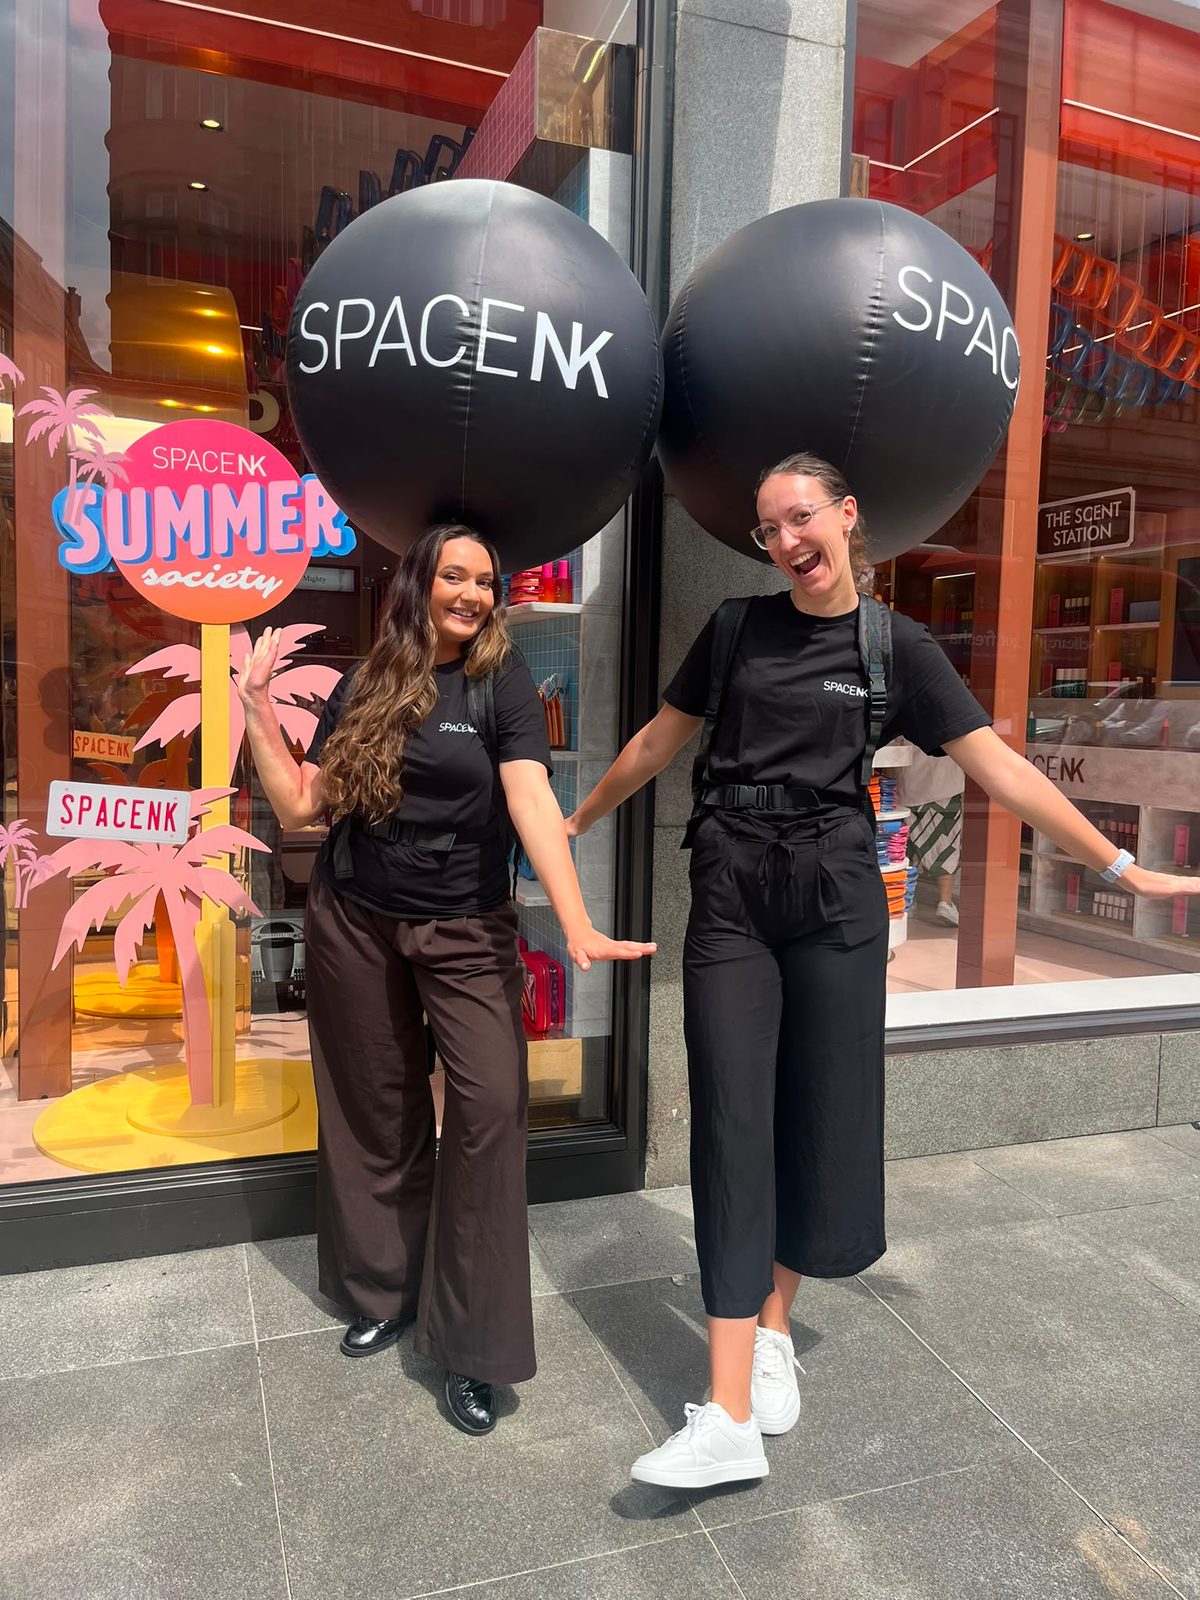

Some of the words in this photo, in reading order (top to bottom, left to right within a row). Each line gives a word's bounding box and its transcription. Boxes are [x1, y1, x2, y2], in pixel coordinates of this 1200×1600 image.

[298, 293, 614, 399] SPACENK
[152, 446, 267, 477] SPACENK
[54, 475, 355, 571] SUMMER
[1045, 510, 1071, 529] THE
[1074, 500, 1122, 524] SCENT
[1053, 522, 1112, 546] STATION
[141, 563, 283, 599] society
[823, 681, 868, 698] SPACENK
[73, 736, 130, 758] SPACENK
[60, 794, 178, 832] SPACENK
